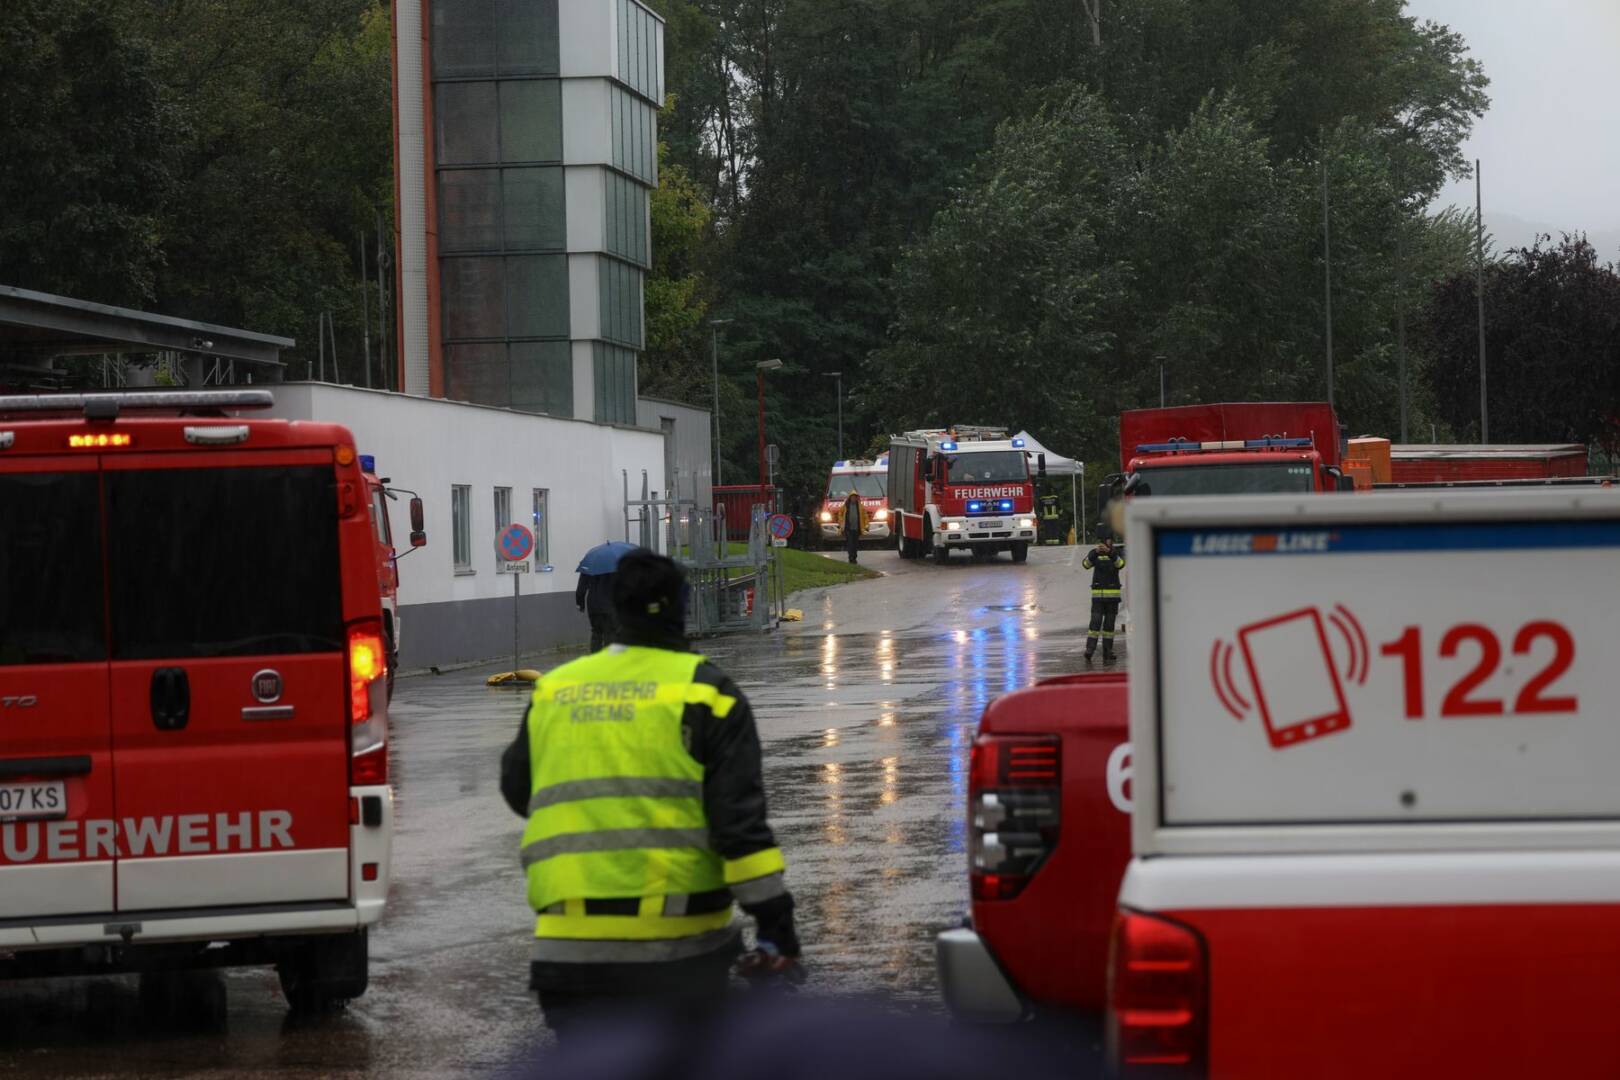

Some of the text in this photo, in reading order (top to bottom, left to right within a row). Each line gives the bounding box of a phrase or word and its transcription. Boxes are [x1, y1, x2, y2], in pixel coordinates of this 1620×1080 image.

[955, 487, 1024, 499] FEUERWEHR
[1191, 531, 1329, 553] LOGIC LINE
[1380, 619, 1580, 720] 122
[258, 679, 277, 694] FIAT
[554, 681, 658, 705] FEUERWEHR
[570, 704, 635, 723] KREMS
[2, 810, 296, 863] UERWEHR
